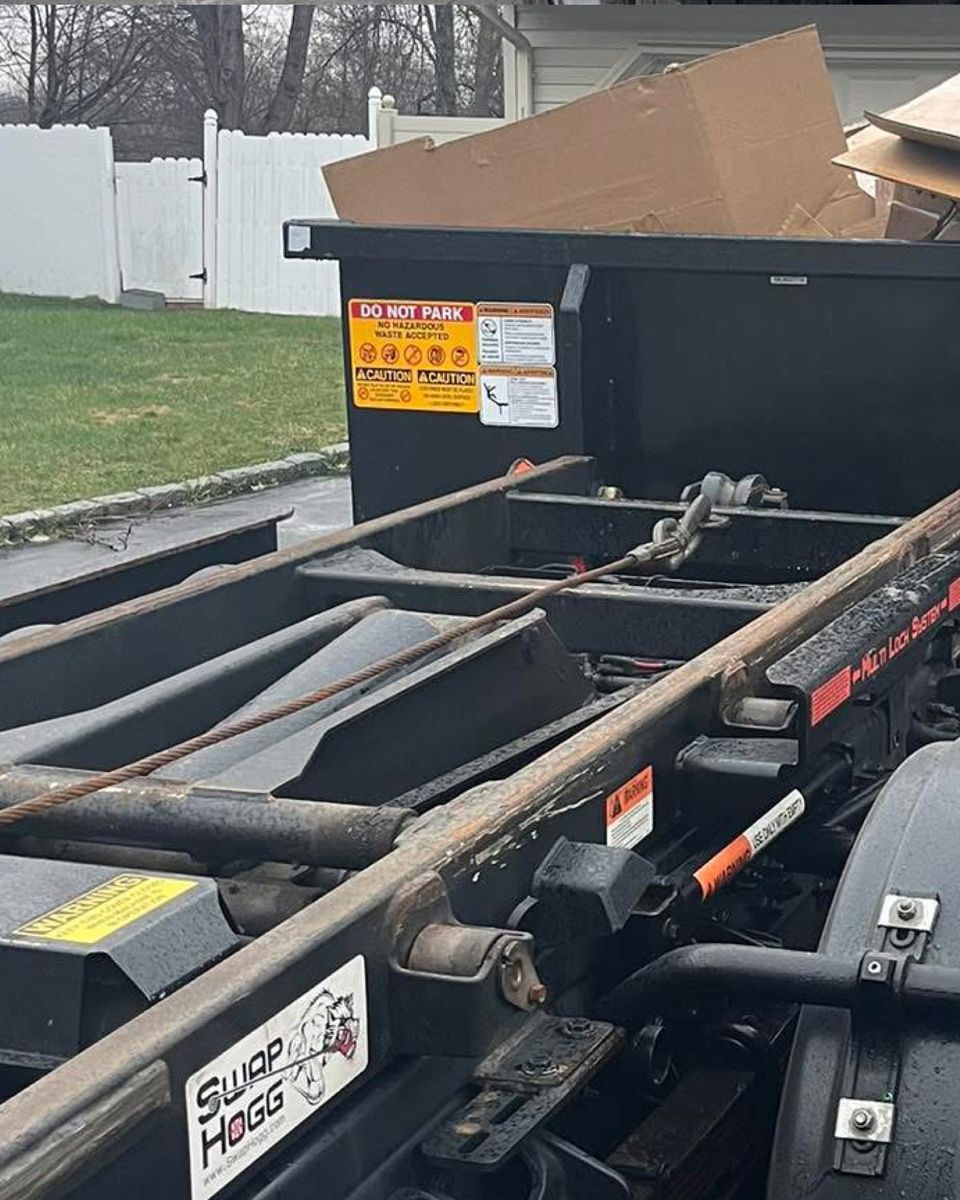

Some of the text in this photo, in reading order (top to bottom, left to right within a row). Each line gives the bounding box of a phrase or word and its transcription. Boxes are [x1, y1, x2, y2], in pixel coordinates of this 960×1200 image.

[360, 303, 464, 321] DO NOT PARK
[378, 321, 445, 331] NO HAZARDOUS
[375, 331, 450, 341] WASTE ACCEPTED
[366, 369, 412, 382] CAUTION
[428, 372, 475, 384] CAUTION
[22, 876, 144, 935] WARNING
[197, 1037, 283, 1125] SWAP
[202, 1078, 284, 1170] HOGG
